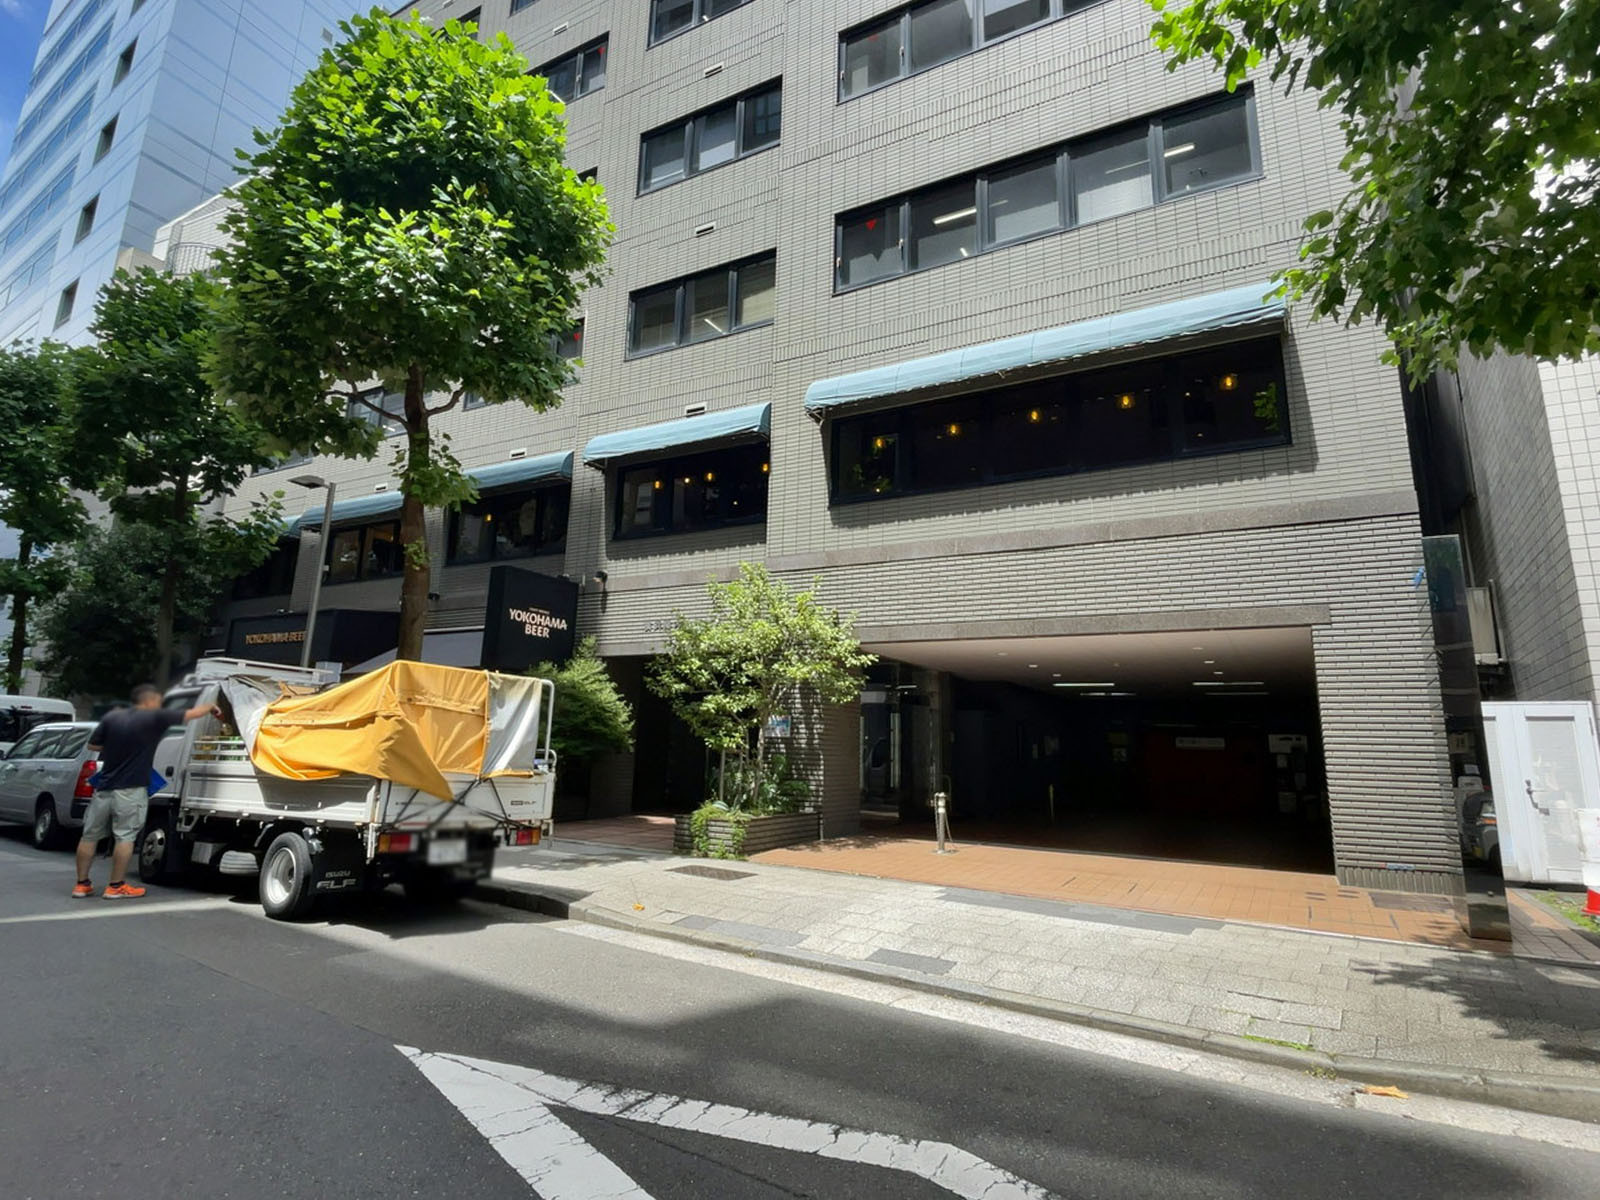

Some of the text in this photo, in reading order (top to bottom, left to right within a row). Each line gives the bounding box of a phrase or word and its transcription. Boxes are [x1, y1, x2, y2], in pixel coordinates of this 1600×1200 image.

[509, 607, 568, 631] YOKOHAMA
[525, 623, 550, 638] BEER
[325, 869, 351, 878] ISUZU
[316, 878, 358, 889] ELF
